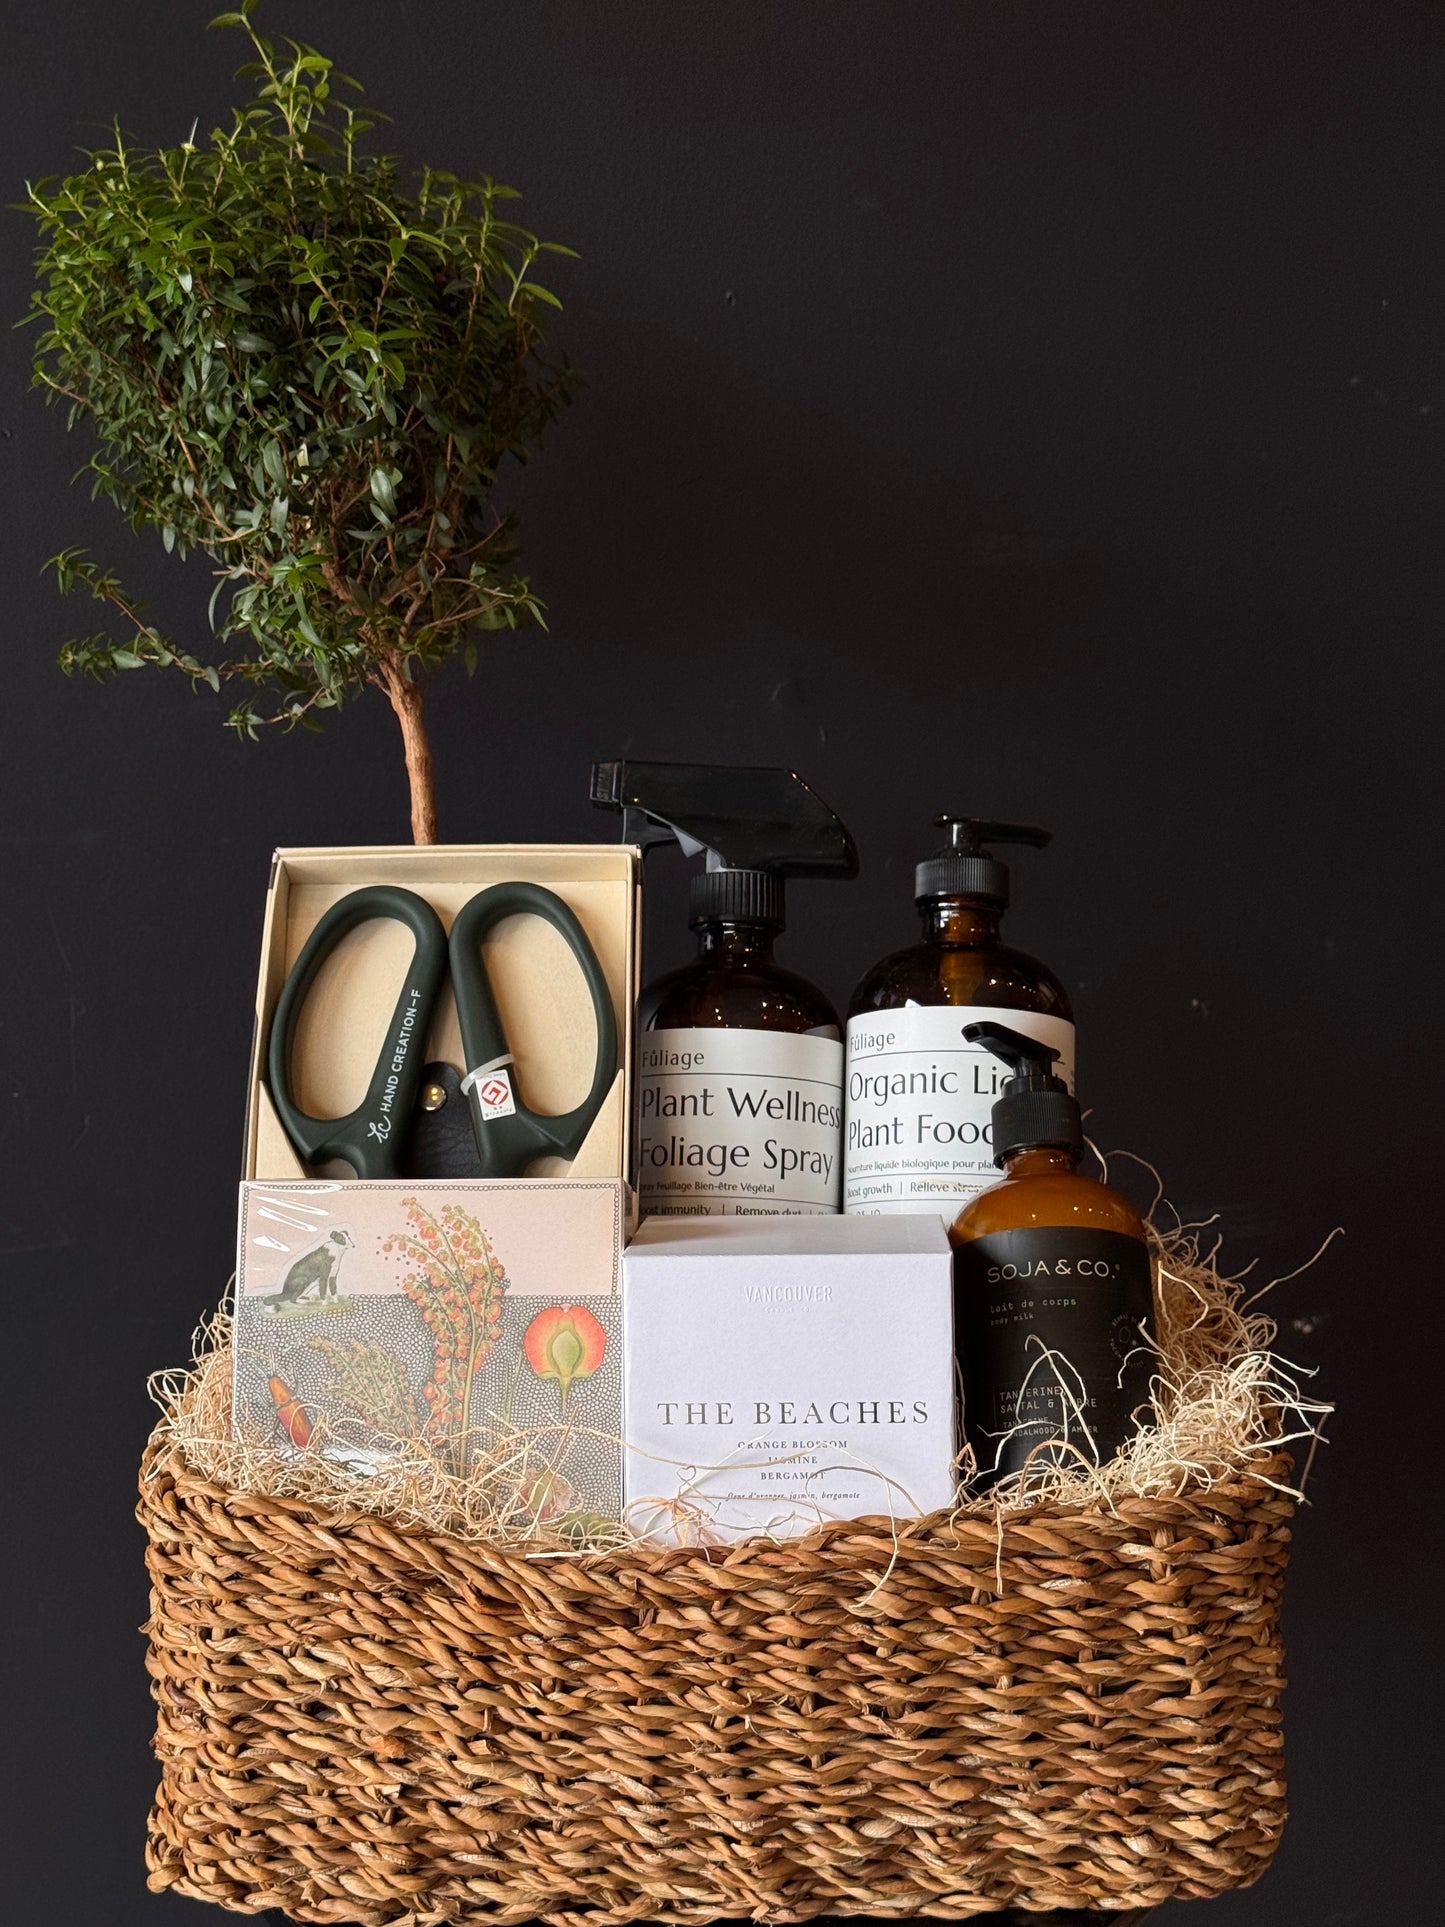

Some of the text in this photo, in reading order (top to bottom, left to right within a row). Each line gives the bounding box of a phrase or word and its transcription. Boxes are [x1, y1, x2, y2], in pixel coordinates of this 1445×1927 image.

[849, 1064, 959, 1107] Organic
[379, 1075, 399, 1113] HAND
[641, 1086, 840, 1130] Plant Wellness
[849, 1116, 904, 1151] Plant
[640, 1135, 834, 1185] Foliage Spray
[874, 1160, 900, 1172] liquide
[901, 1159, 950, 1171] biologique
[952, 1160, 975, 1170] pour
[695, 1181, 738, 1192] Bien-être
[740, 1182, 776, 1194] Végétal
[862, 1183, 893, 1199] growth
[910, 1181, 949, 1193] Relieve
[735, 1204, 780, 1216] Remove
[744, 1285, 833, 1303] VANCOUVER
[1042, 1298, 1077, 1308] corps
[999, 1385, 1066, 1402] TANERINE,
[1046, 1398, 1055, 1409] &
[657, 1400, 929, 1426] THE BEACHES
[1071, 1425, 1099, 1434] AMER
[737, 1440, 788, 1450] ORANGE
[760, 1471, 826, 1481] BERGAMOT
[821, 1491, 861, 1502] bergamote
